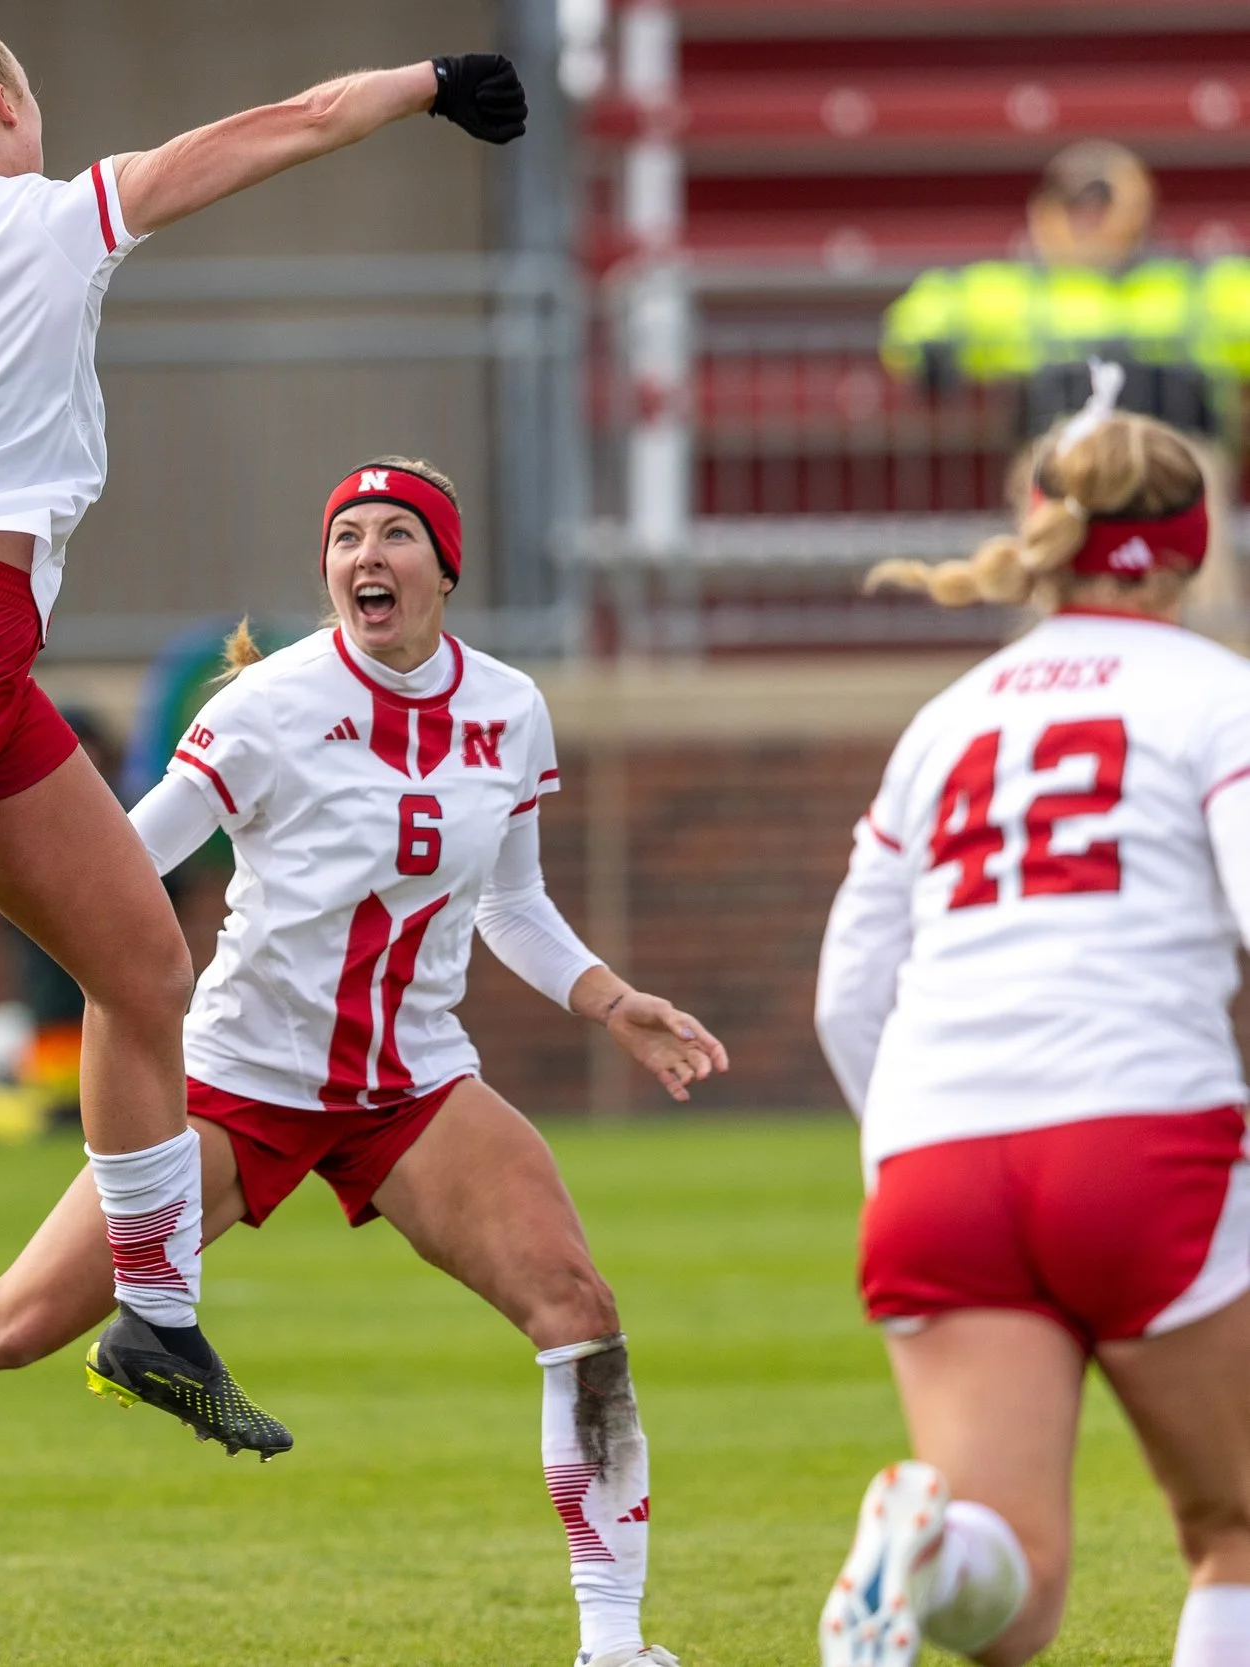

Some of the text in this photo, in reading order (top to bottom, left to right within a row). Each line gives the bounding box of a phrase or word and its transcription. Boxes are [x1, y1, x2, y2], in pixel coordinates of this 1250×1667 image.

[358, 471, 389, 492] N
[461, 719, 507, 770] N
[395, 793, 443, 876] 6
[928, 716, 1129, 912] 42
